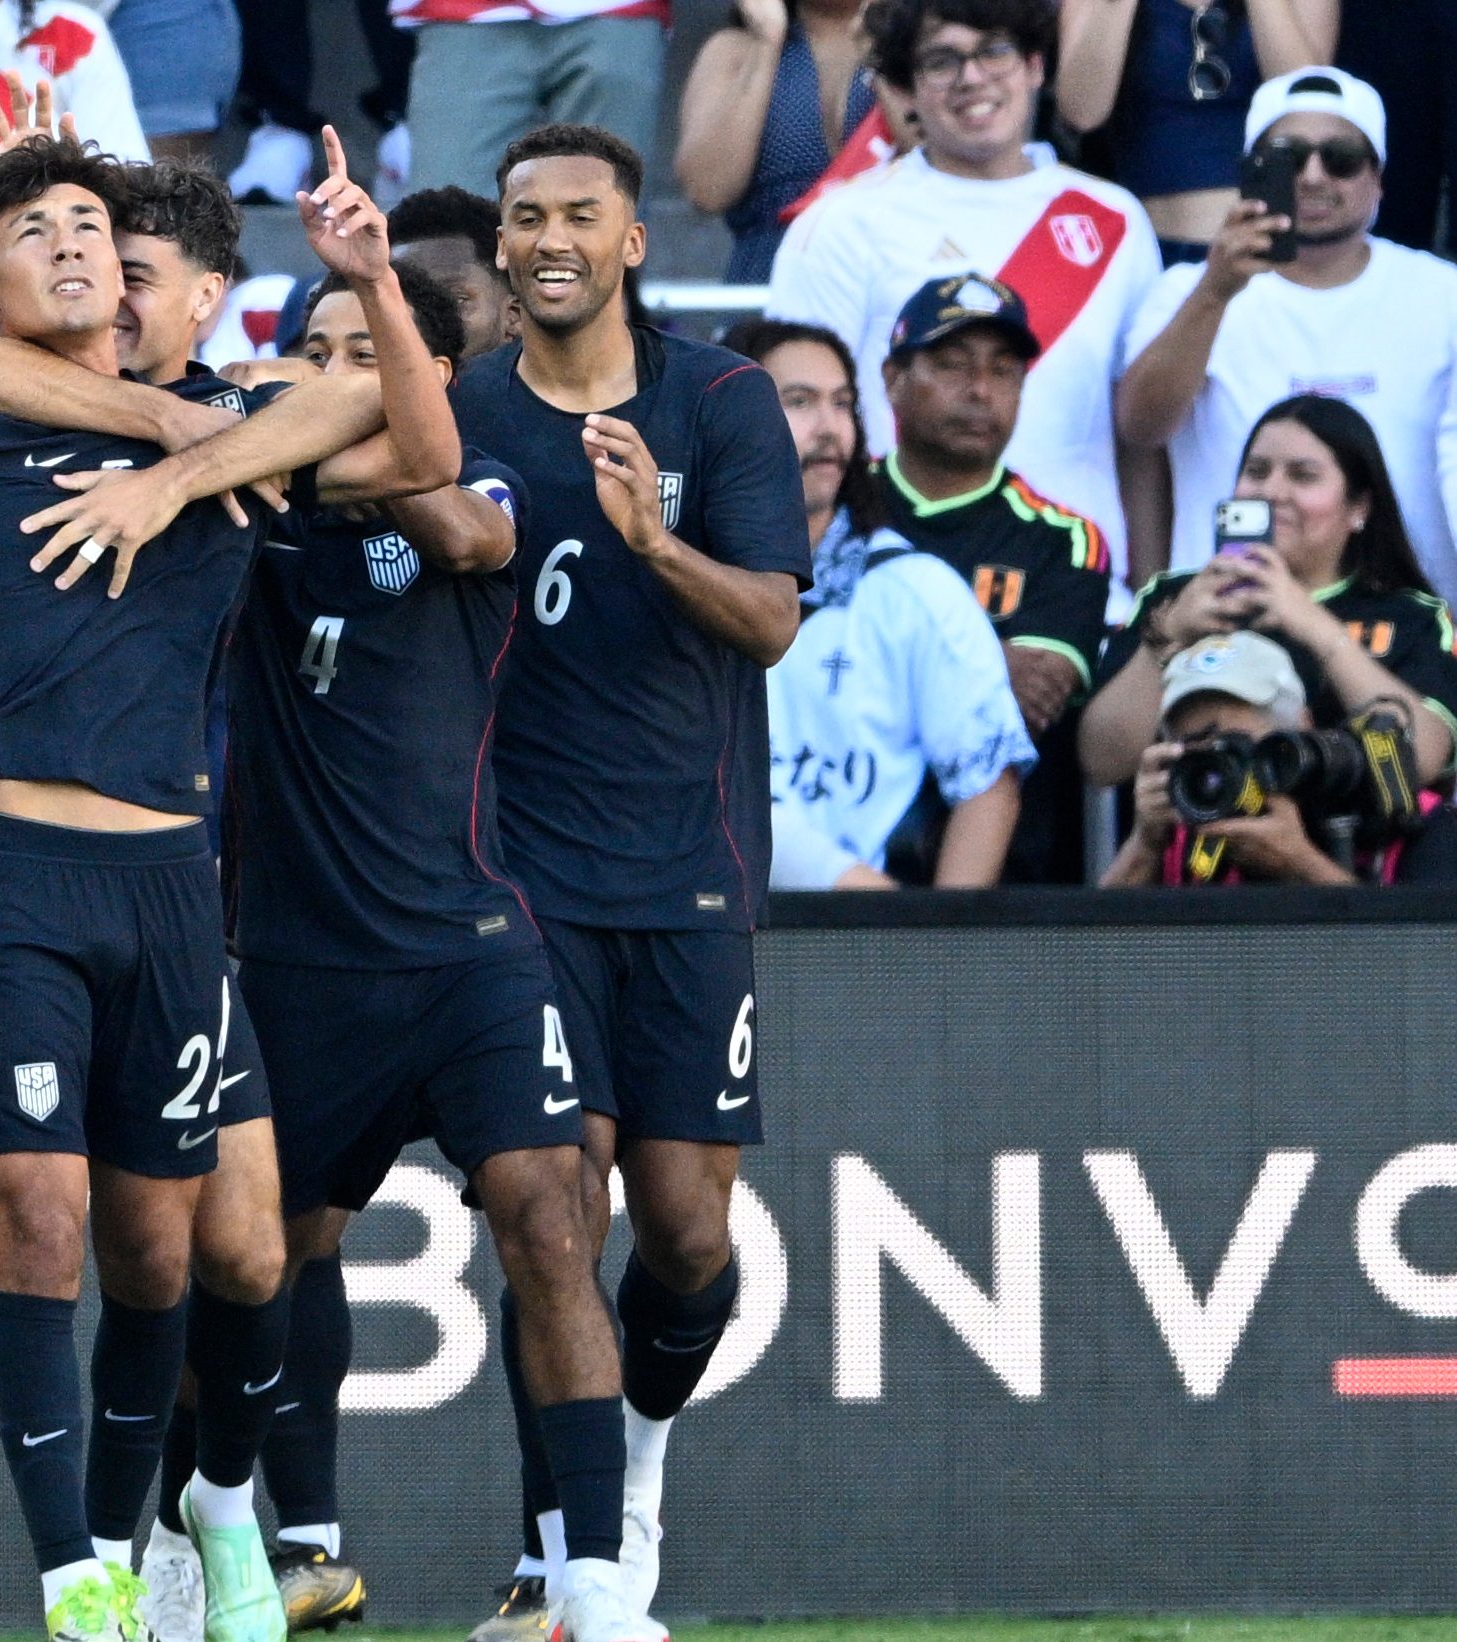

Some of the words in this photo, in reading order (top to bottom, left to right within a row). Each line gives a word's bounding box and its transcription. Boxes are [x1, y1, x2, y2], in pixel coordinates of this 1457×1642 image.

[534, 538, 584, 626] 6
[298, 615, 345, 695] 4
[771, 744, 877, 804] なり
[543, 1003, 573, 1083] 4
[728, 993, 754, 1079] 6
[18, 1064, 55, 1090] USA
